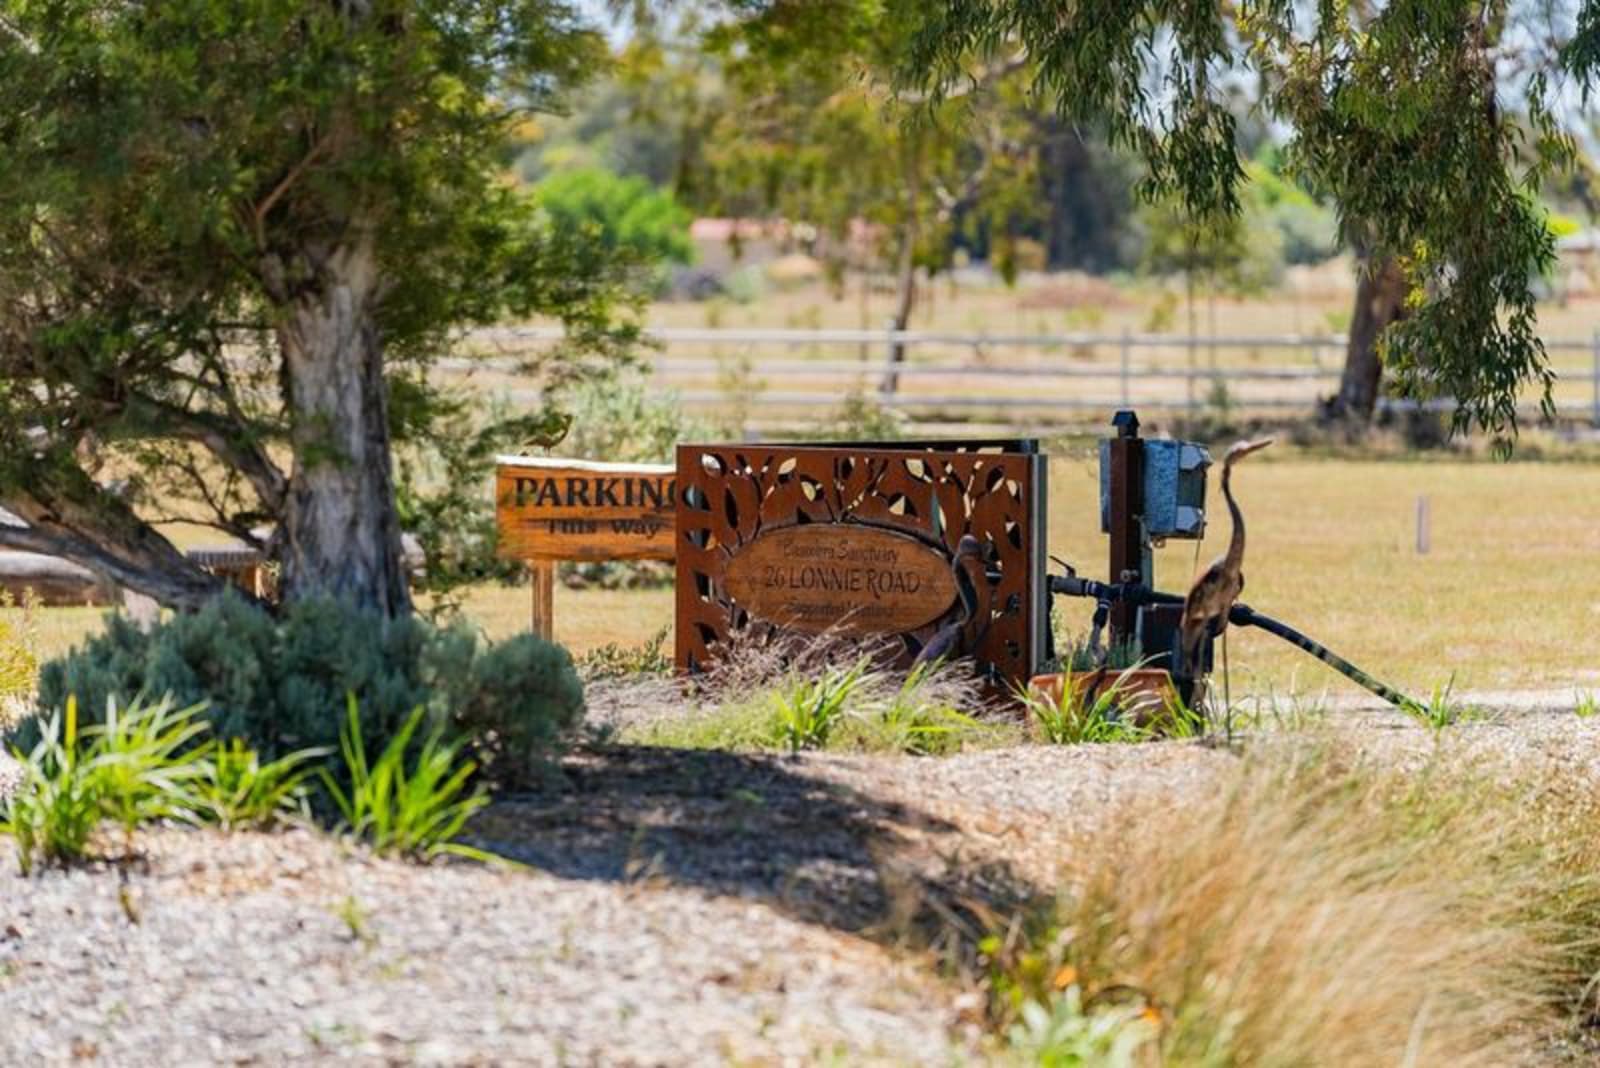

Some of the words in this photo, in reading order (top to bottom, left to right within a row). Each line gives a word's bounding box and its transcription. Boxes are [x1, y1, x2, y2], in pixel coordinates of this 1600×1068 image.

[765, 564, 785, 588] 26
[789, 566, 862, 592] LONNIE
[867, 568, 921, 598] ROAD
